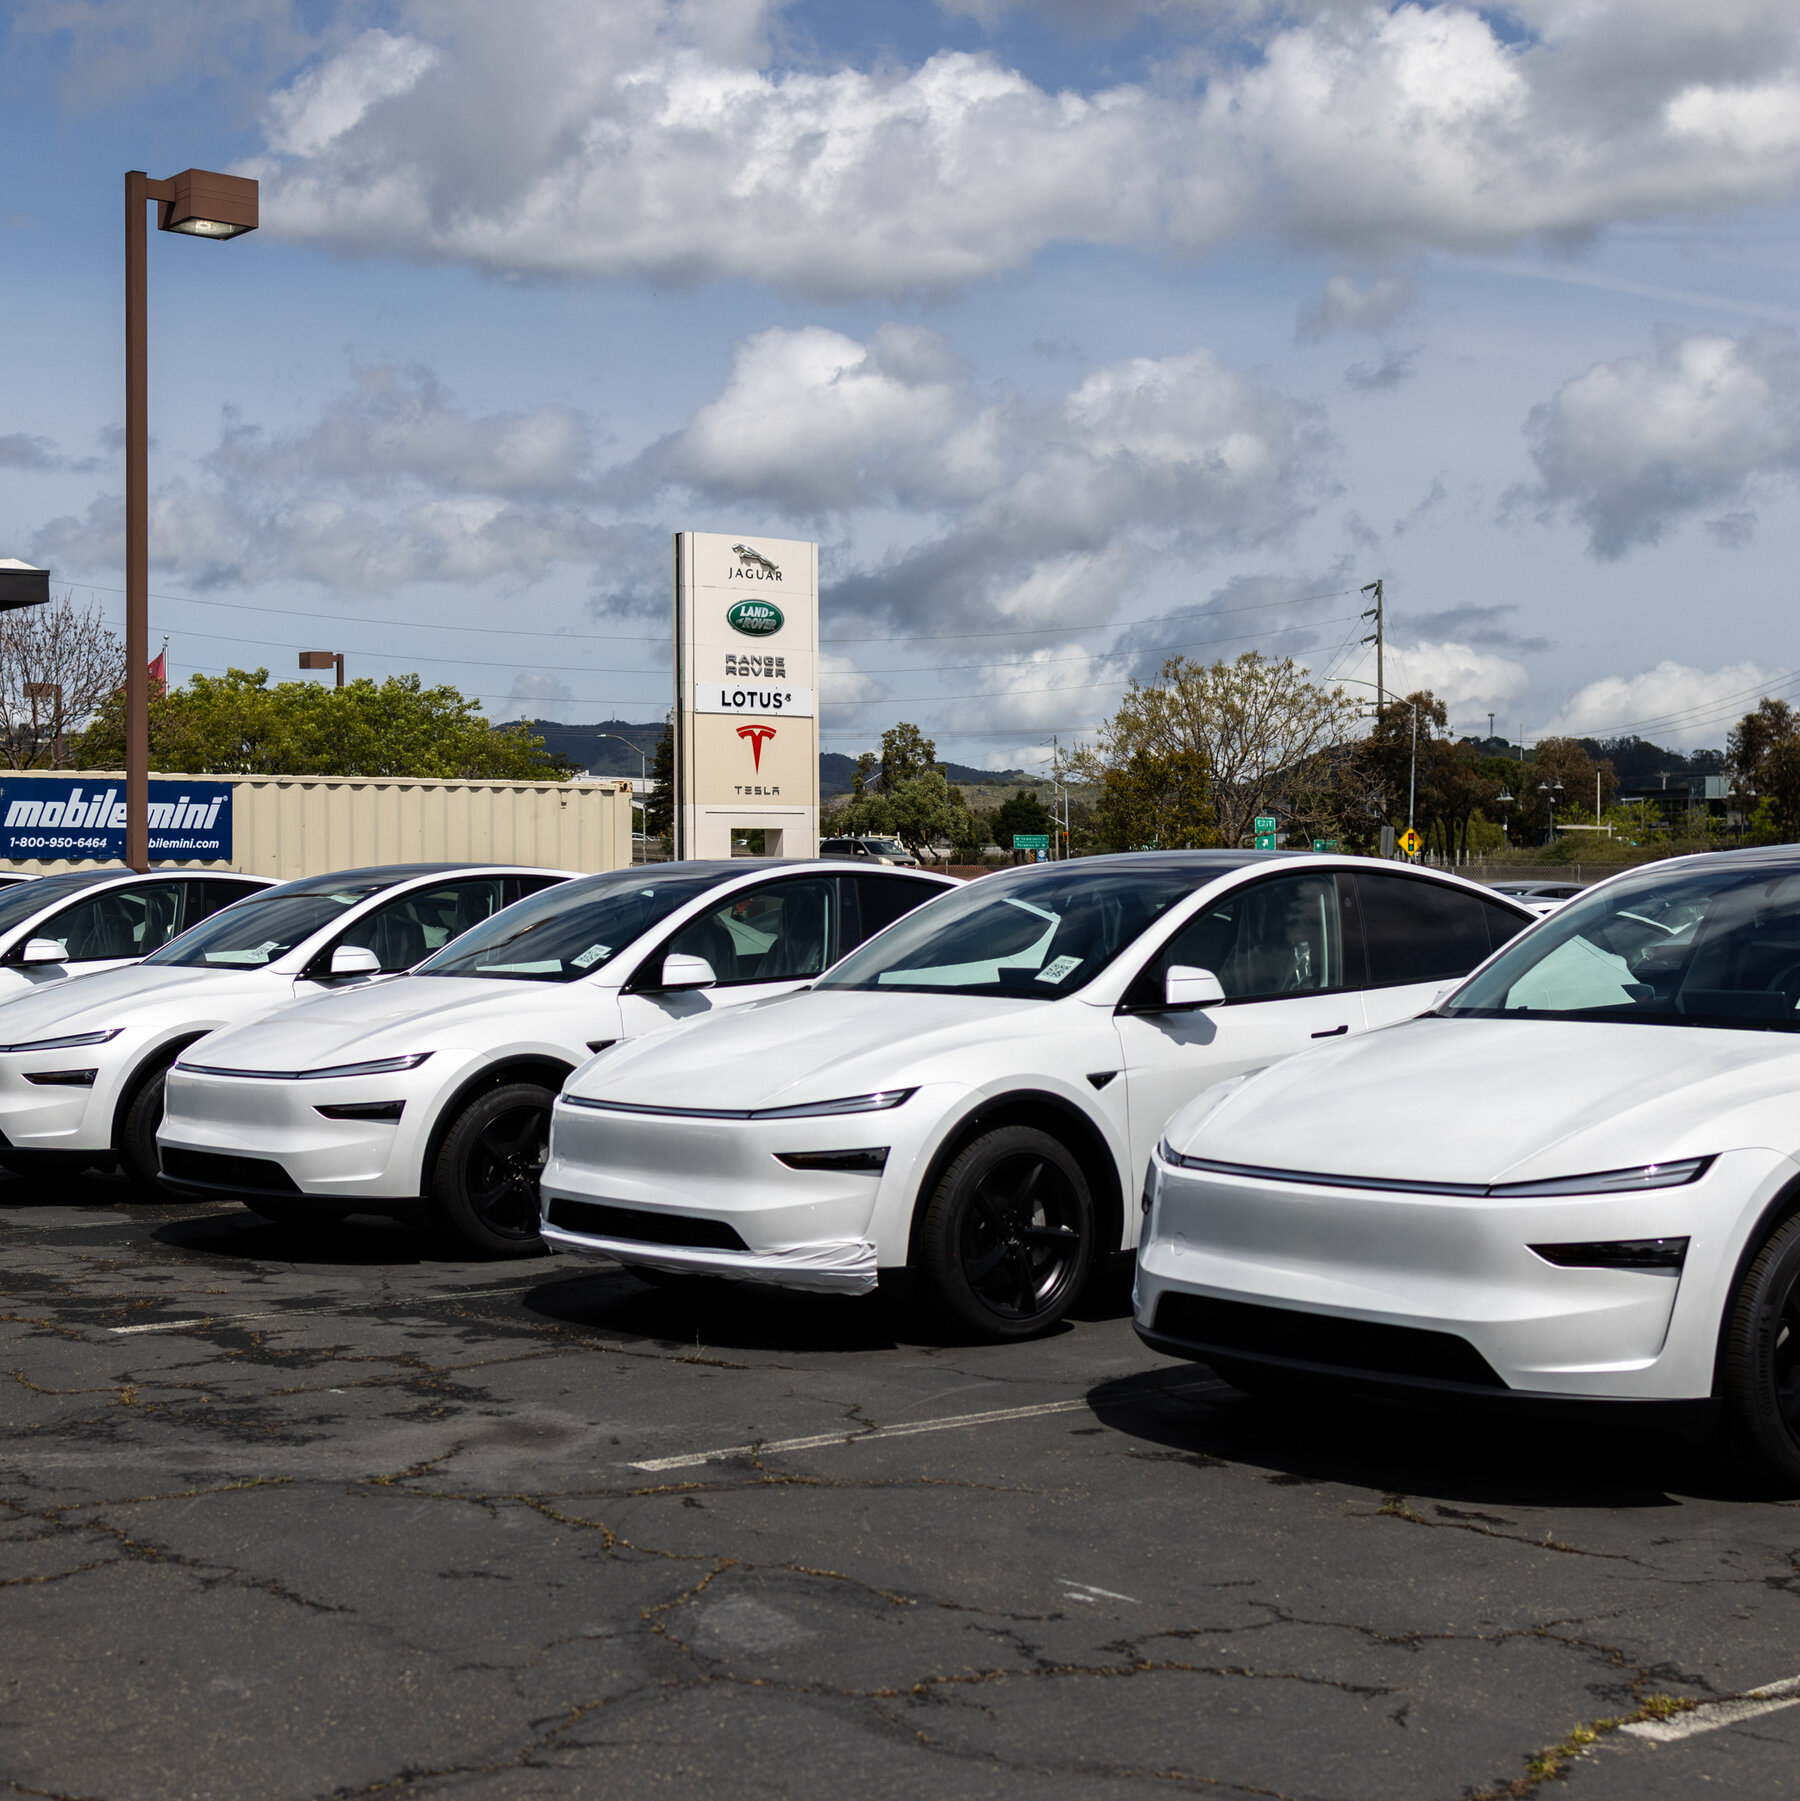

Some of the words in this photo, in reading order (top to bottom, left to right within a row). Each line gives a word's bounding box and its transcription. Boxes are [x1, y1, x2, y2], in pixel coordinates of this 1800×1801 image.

[728, 567, 783, 581] JAGUAR
[740, 606, 769, 618] LAND
[742, 617, 777, 630] ROVER
[725, 654, 785, 667] RANGE
[725, 665, 786, 678] ROVER
[721, 690, 783, 709] LOTUS
[734, 785, 780, 796] TESLA
[3, 788, 127, 828] mobile
[9, 837, 108, 848] 1-800-950-6464
[148, 838, 220, 848] bilemini.com
